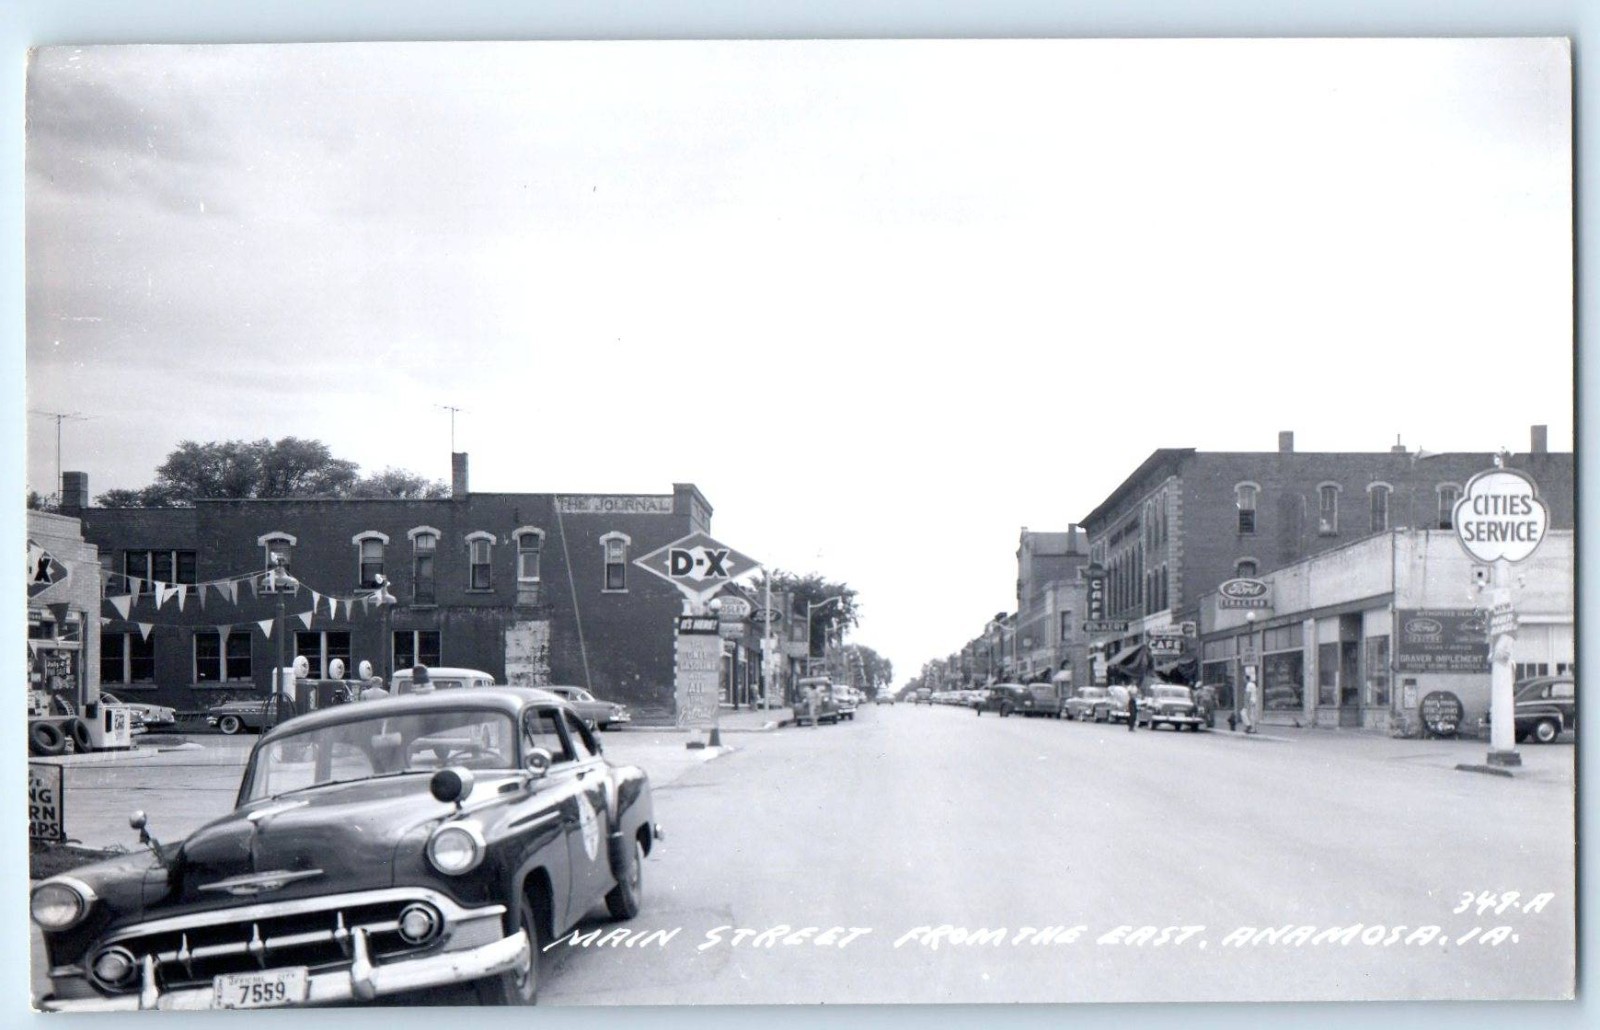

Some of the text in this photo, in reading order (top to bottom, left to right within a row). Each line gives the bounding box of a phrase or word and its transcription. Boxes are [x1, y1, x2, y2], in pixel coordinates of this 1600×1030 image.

[560, 498, 670, 512] THE JOURNAL
[1472, 494, 1533, 516] CITIES
[1463, 521, 1538, 543] SERVICE
[1227, 581, 1262, 595] Ford
[1148, 640, 1181, 649] CAFE
[238, 981, 286, 1004] 7559
